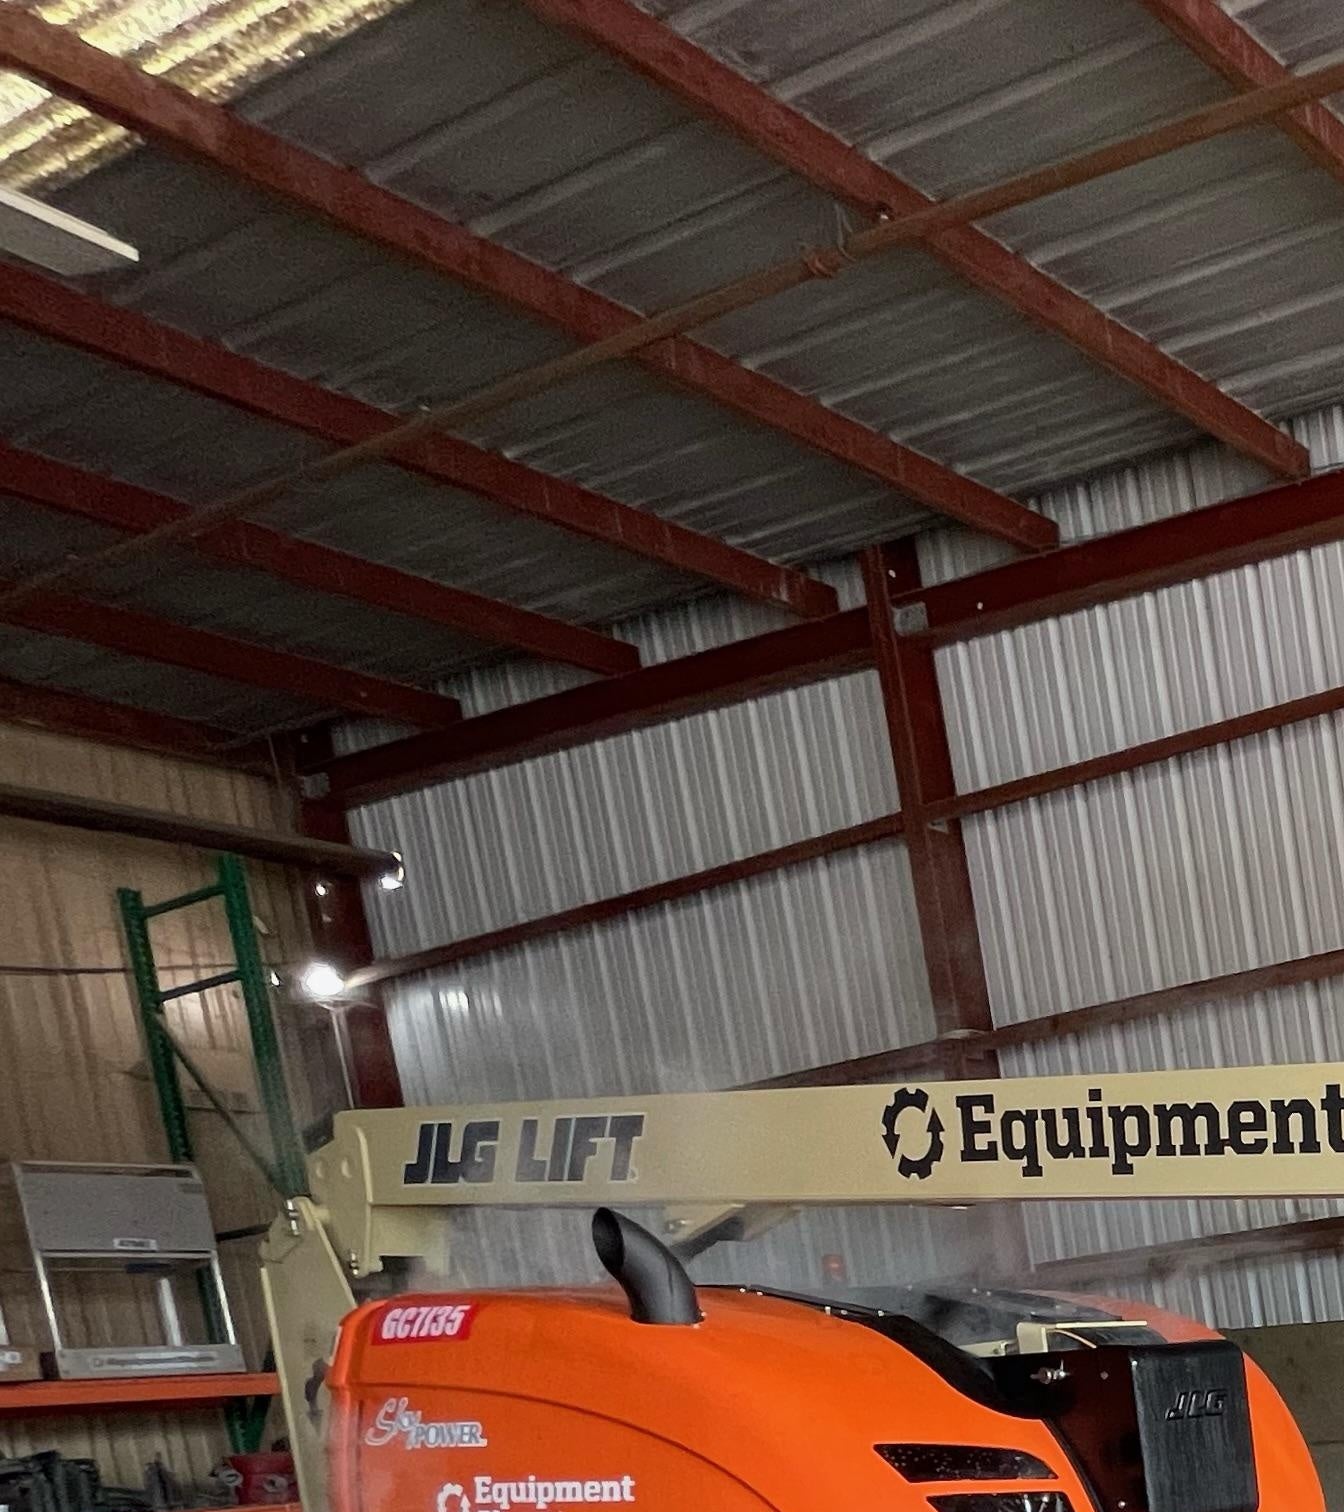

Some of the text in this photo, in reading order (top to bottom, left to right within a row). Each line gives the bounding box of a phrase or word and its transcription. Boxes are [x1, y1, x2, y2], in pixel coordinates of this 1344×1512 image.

[404, 1114, 645, 1184] JLG LIFT
[1164, 1389, 1228, 1420] JLG
[473, 1475, 635, 1510] Equipment
